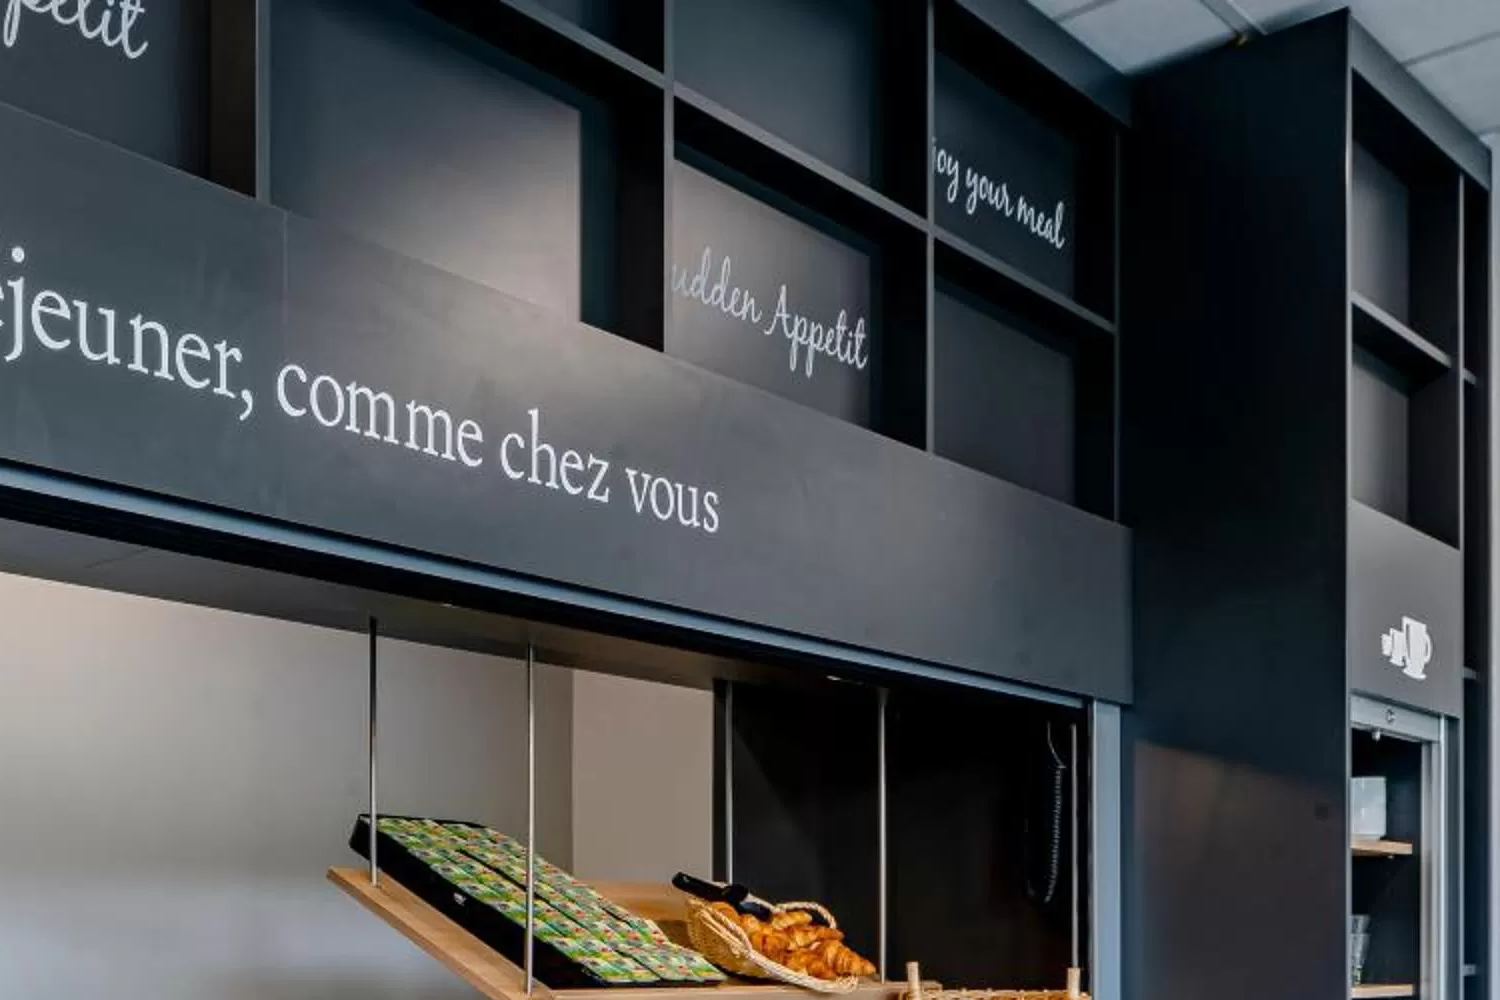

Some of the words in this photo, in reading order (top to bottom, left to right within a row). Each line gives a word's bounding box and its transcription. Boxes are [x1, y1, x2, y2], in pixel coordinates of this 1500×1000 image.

[965, 167, 1015, 217] your
[1016, 195, 1066, 249] meal
[763, 283, 869, 378] Appetit
[276, 363, 484, 467] comme
[500, 408, 610, 503] chez
[625, 467, 719, 533] vous
